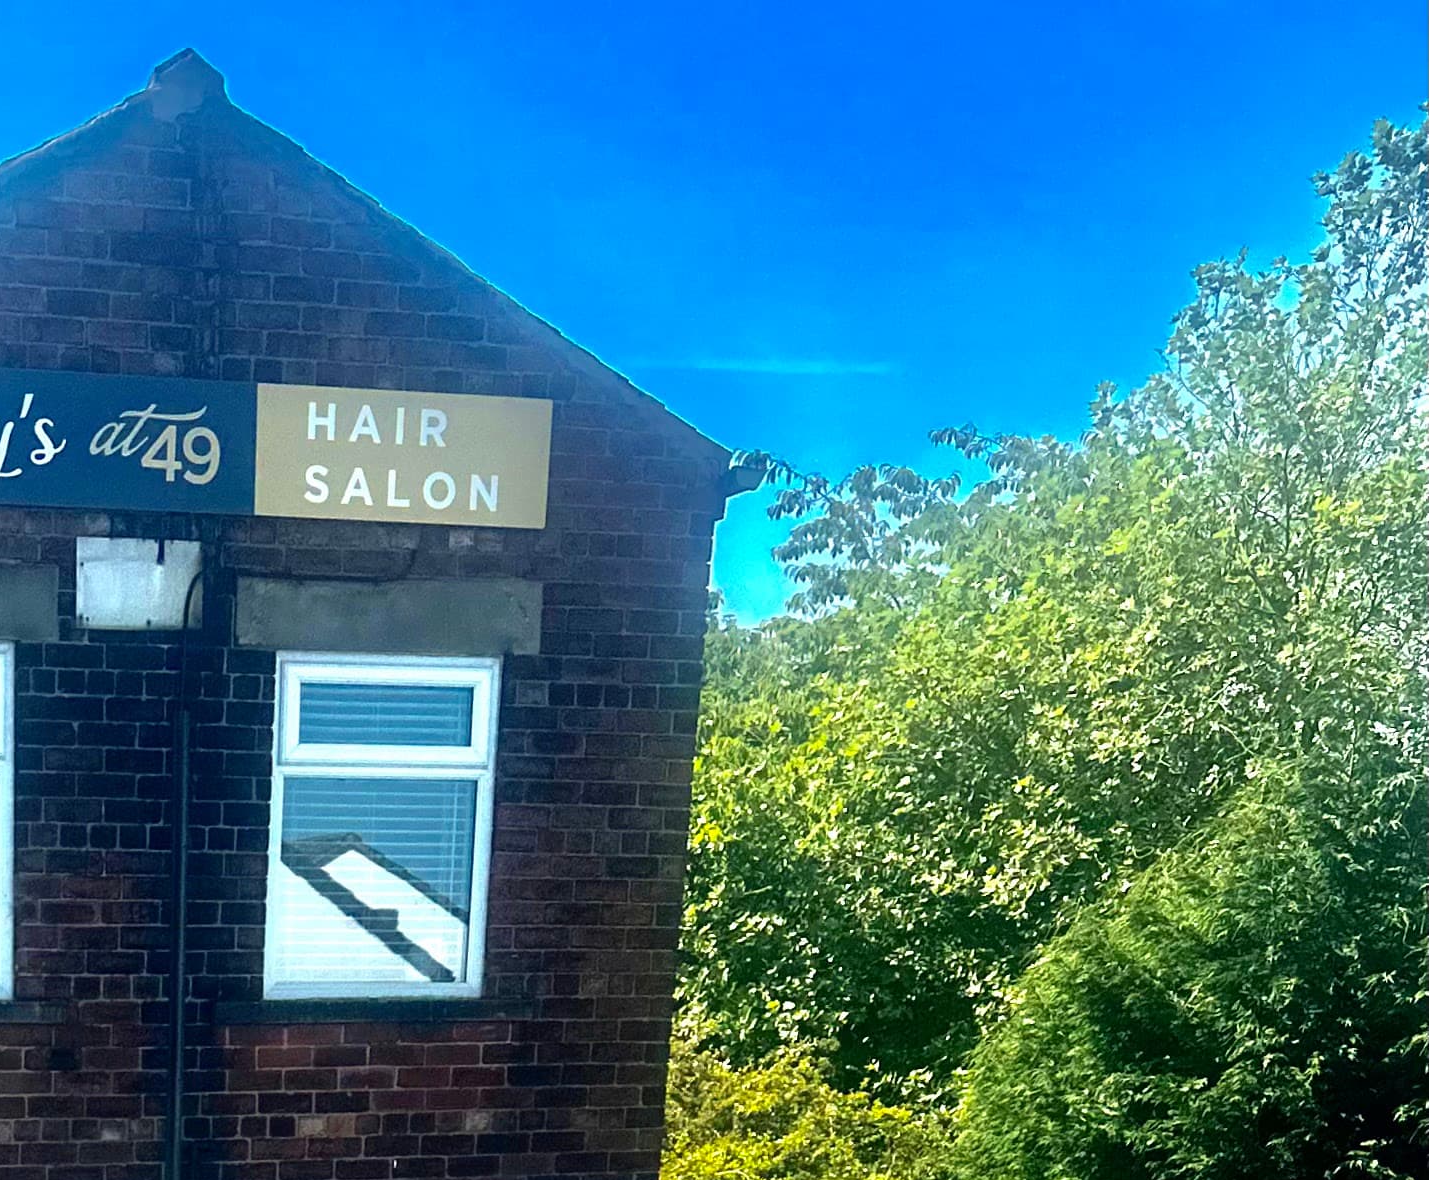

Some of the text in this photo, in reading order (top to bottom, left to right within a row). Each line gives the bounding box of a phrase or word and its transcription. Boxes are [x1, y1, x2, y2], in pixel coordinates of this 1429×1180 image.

[88, 404, 206, 457] at
[306, 402, 449, 448] HAIR
[138, 426, 221, 485] 49
[303, 464, 500, 513] SALON
